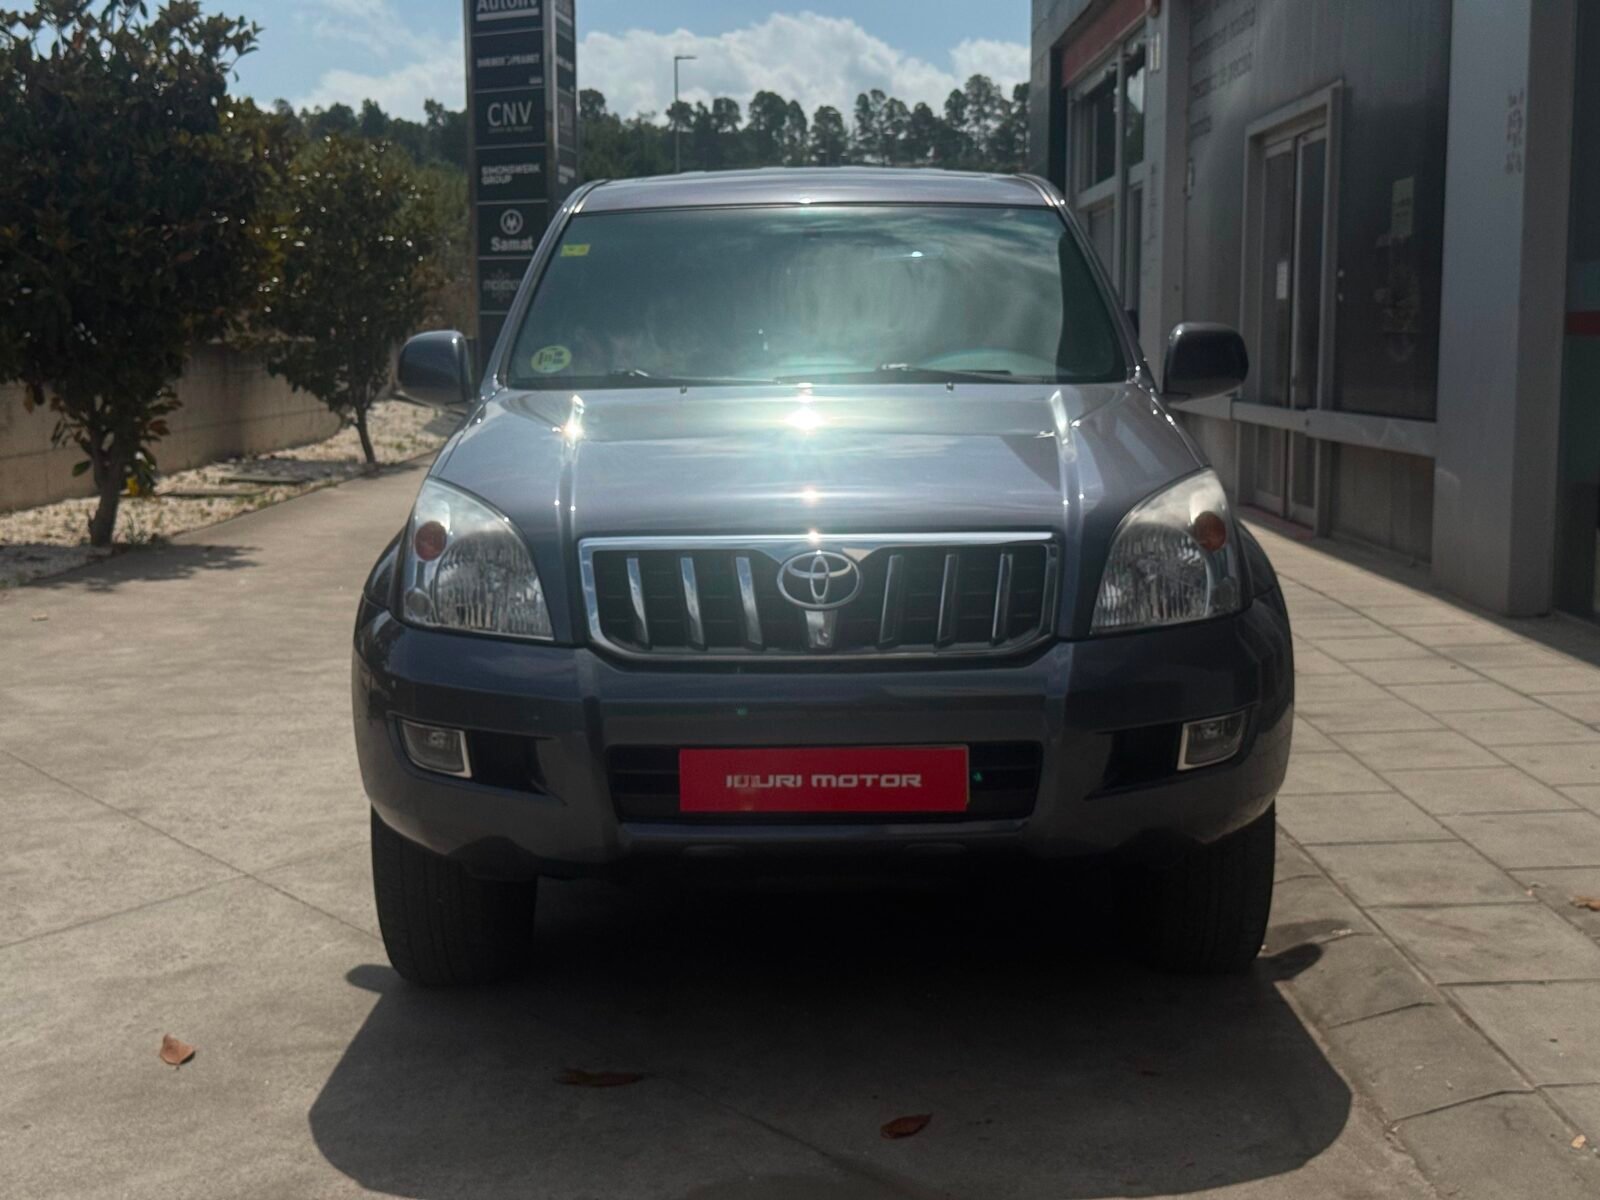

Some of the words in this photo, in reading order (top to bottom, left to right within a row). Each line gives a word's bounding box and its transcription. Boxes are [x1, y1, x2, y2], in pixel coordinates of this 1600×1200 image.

[487, 101, 533, 127] CNV
[491, 236, 534, 252] Samat
[811, 774, 922, 788] MOTOR
